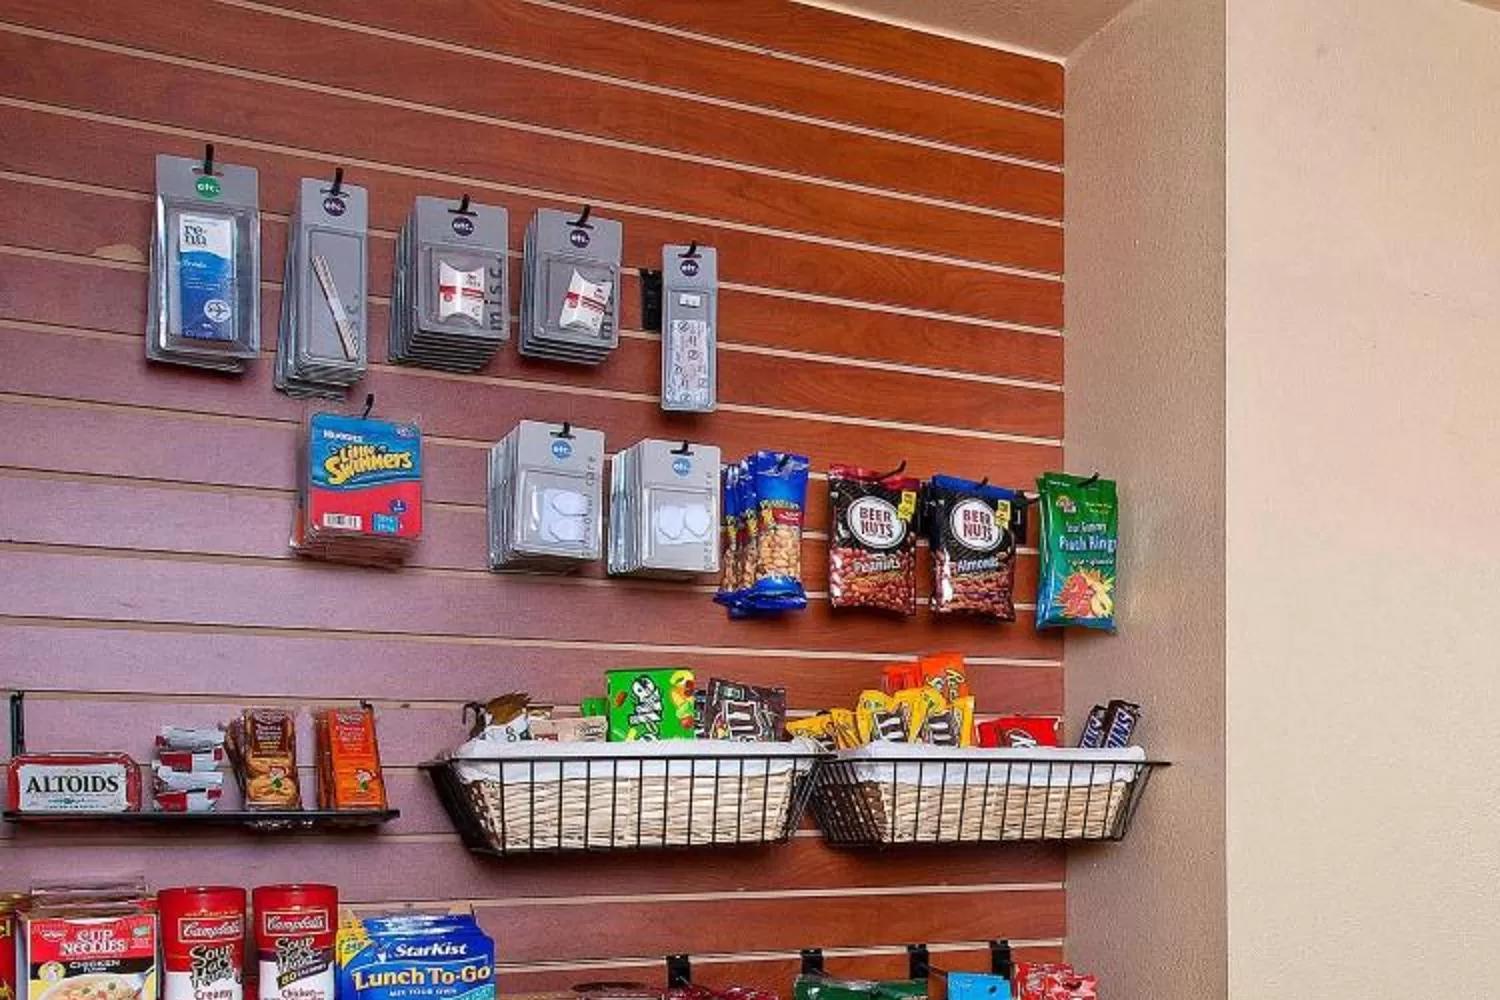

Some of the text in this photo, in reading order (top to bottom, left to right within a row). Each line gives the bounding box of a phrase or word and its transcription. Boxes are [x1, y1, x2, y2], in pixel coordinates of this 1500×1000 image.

[859, 506, 893, 523] BEER
[962, 508, 991, 525] BEER
[859, 520, 895, 537] NUTS
[962, 522, 995, 541] NUTS
[27, 775, 119, 795] ALTOIDS
[60, 939, 128, 955] NOODLES
[190, 944, 235, 963] Soup
[395, 942, 468, 958] StarKist
[353, 963, 491, 991] Lunch To-Go
